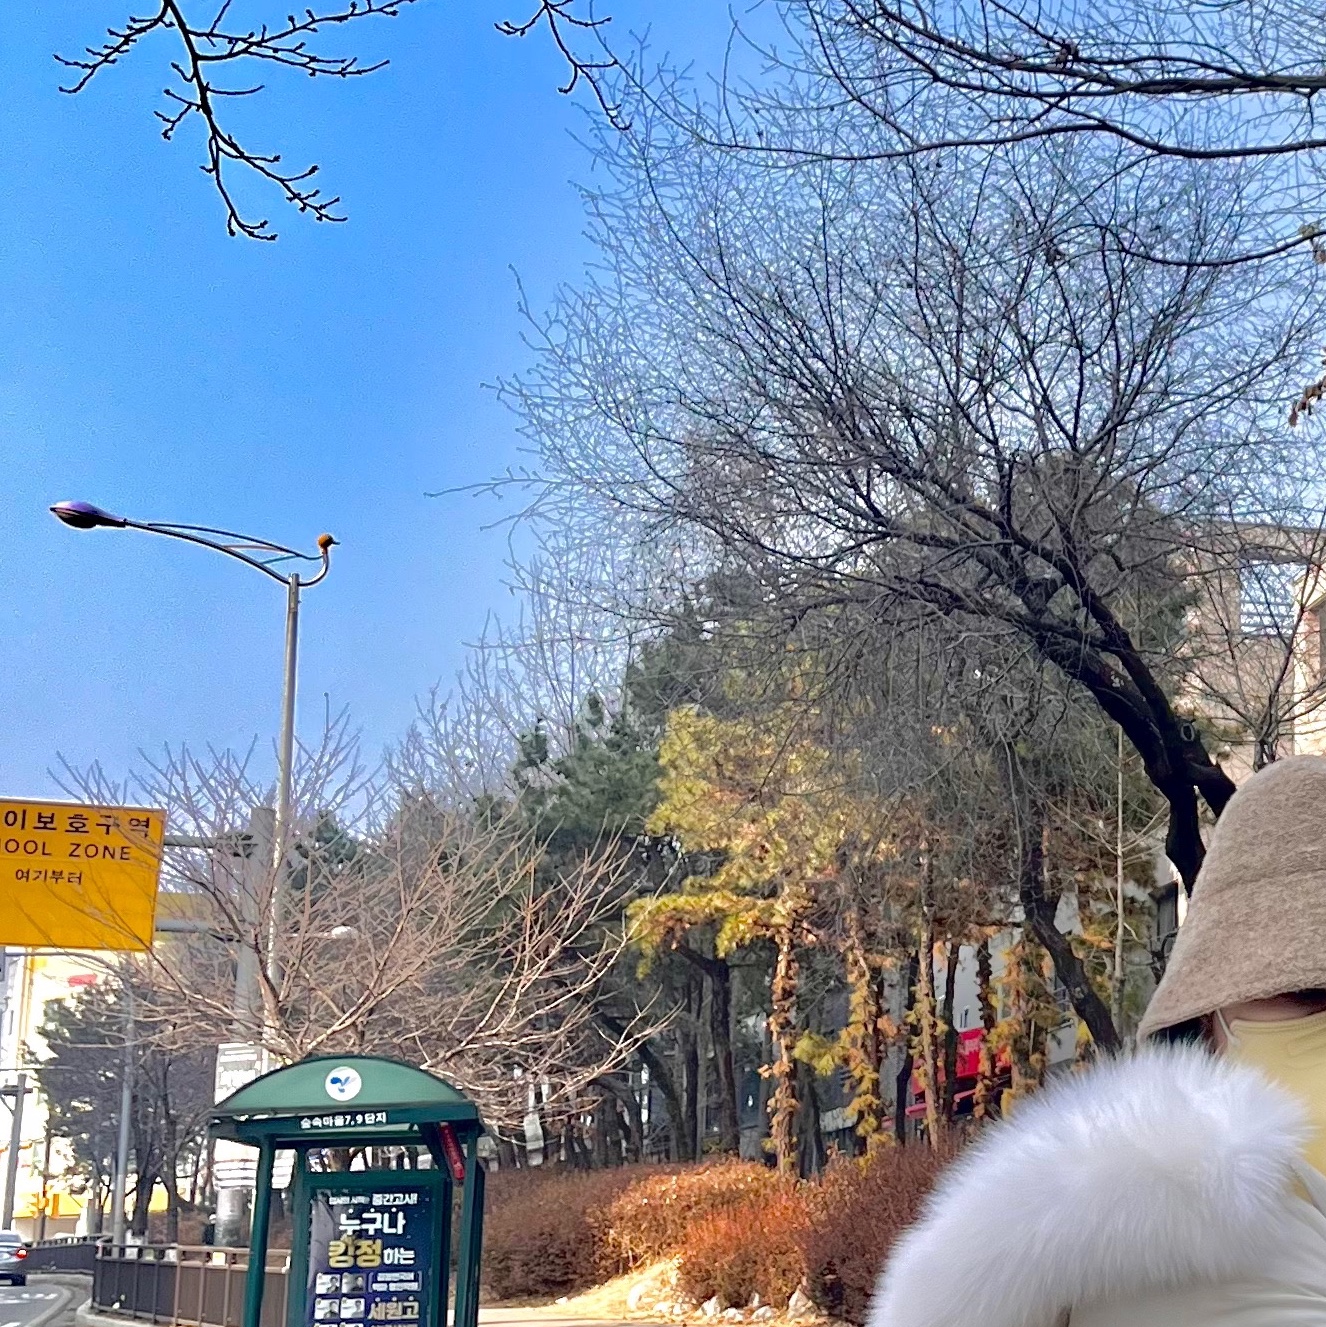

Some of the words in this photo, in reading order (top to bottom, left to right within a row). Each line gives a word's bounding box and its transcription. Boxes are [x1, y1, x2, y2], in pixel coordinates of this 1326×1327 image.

[68, 842, 132, 861] ZONE
[15, 868, 84, 886] 여기부터
[339, 1211, 406, 1236] 누구나
